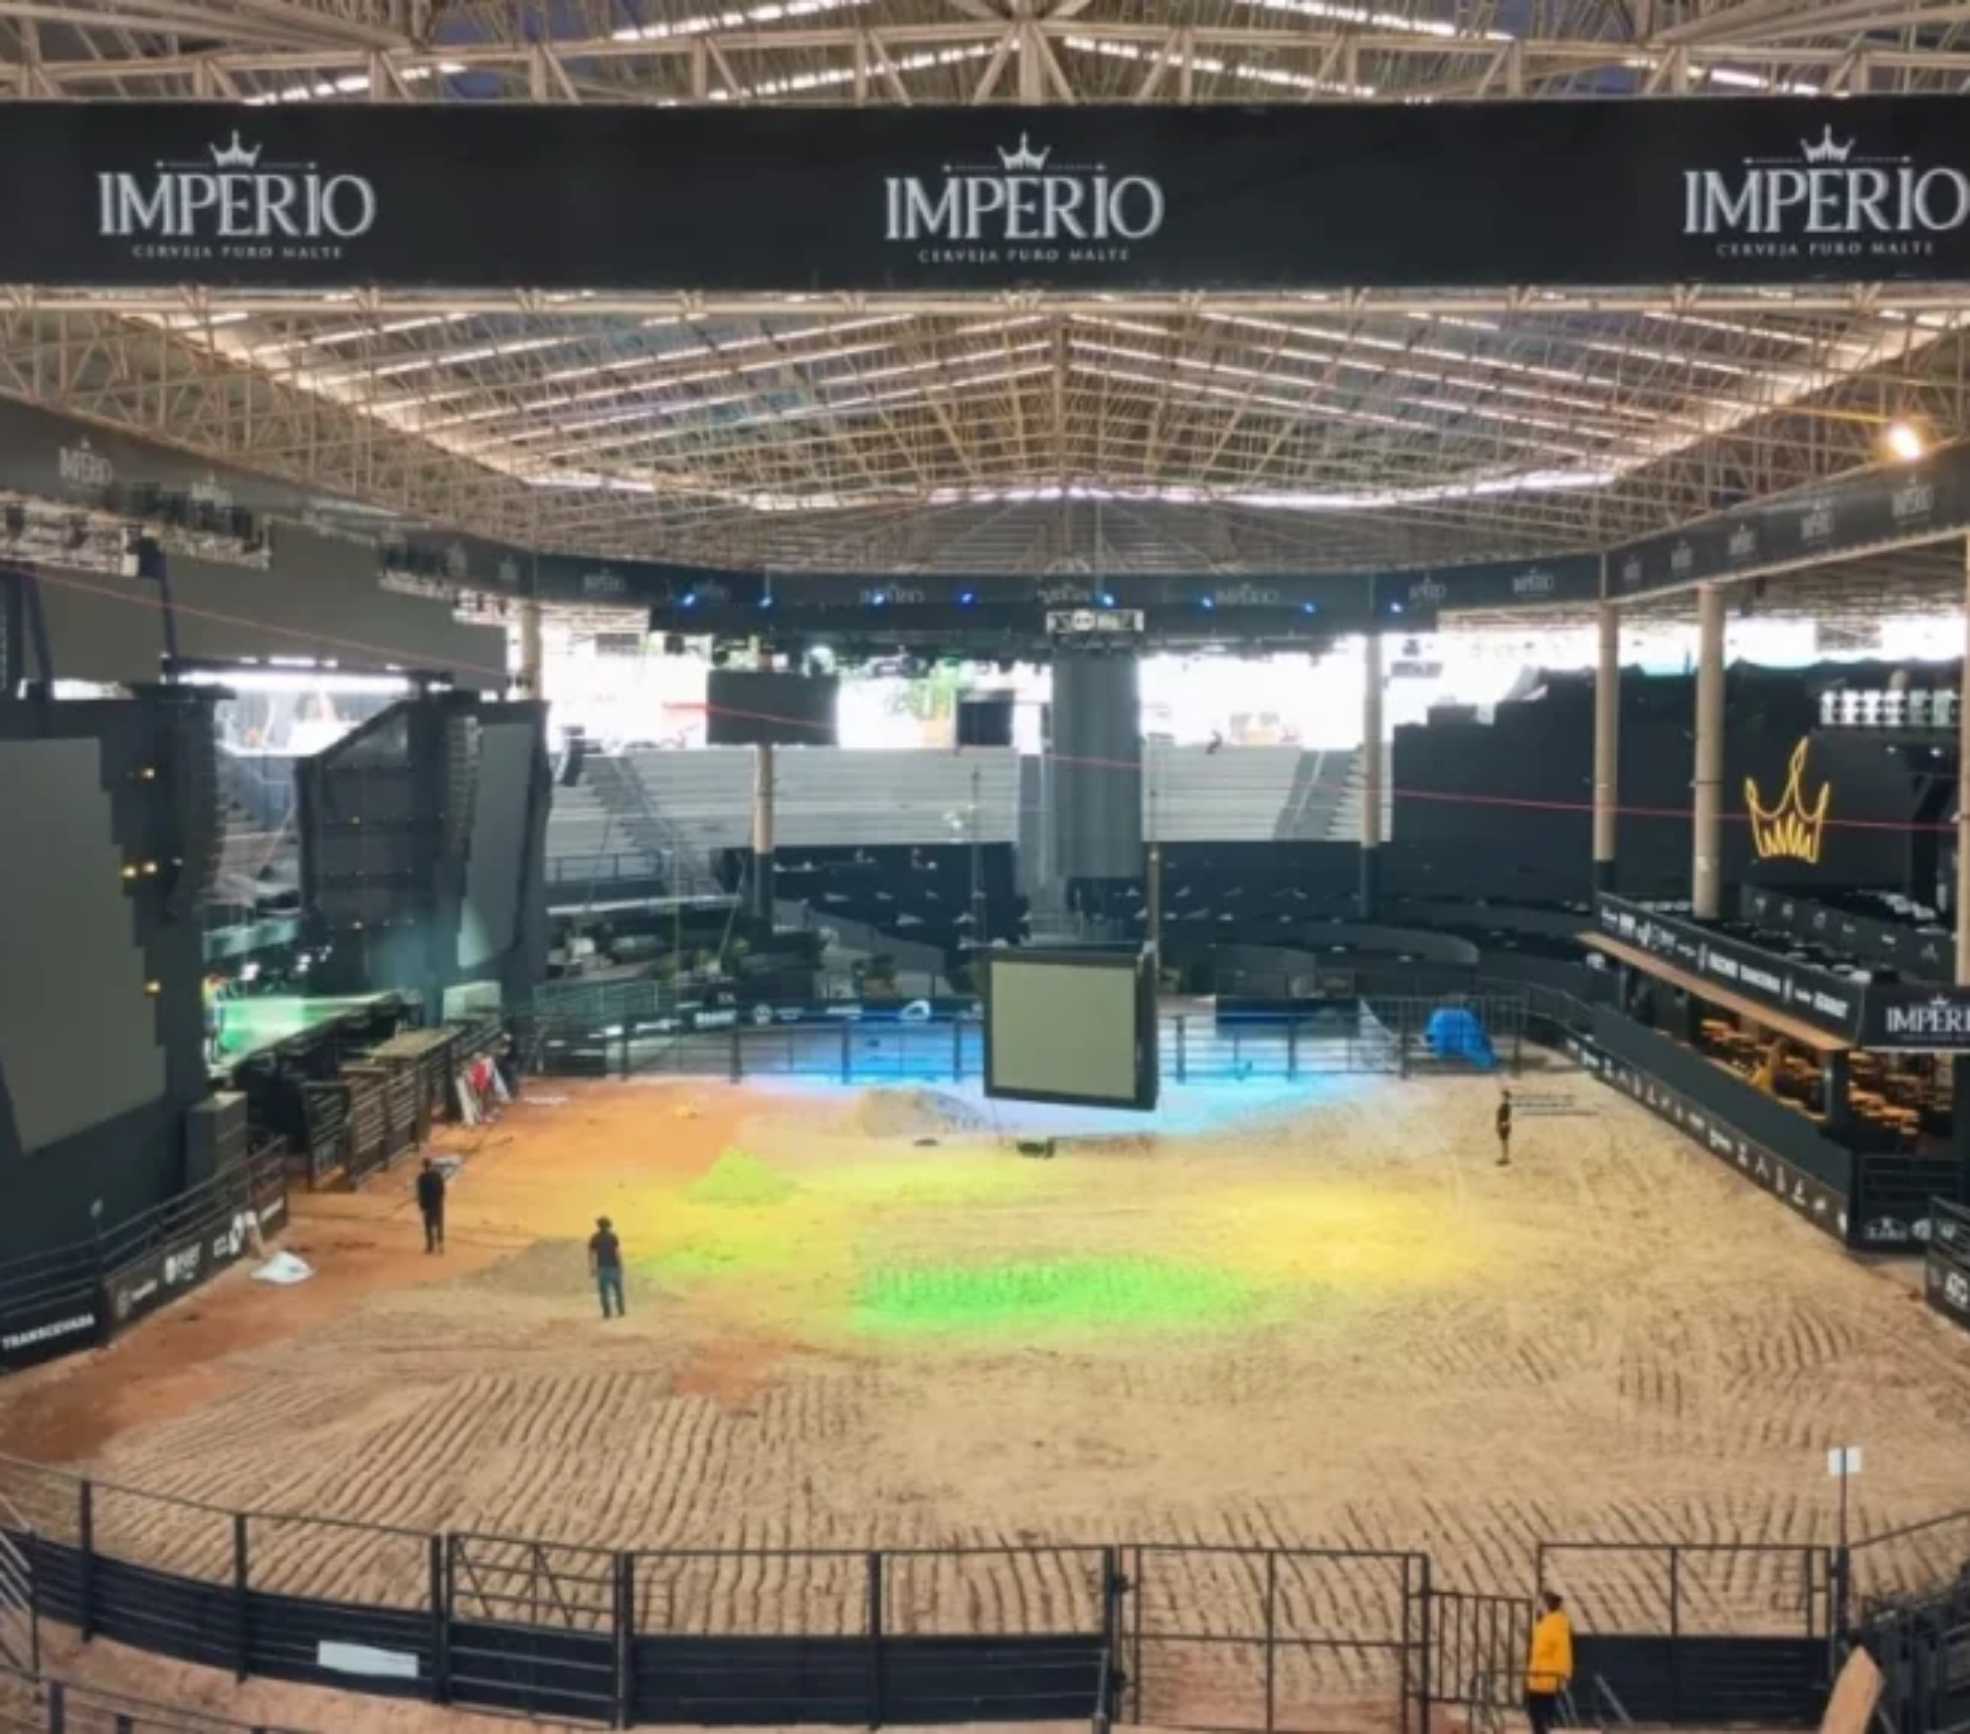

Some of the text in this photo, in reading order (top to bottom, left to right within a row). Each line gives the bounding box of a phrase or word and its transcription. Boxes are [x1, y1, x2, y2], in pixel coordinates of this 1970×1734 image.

[132, 245, 342, 260] CERVEJA PURO MALTE
[917, 248, 1131, 264] CERVEJA PURO MALTE
[1716, 241, 1934, 258] CERVEJA PURO MALTE
